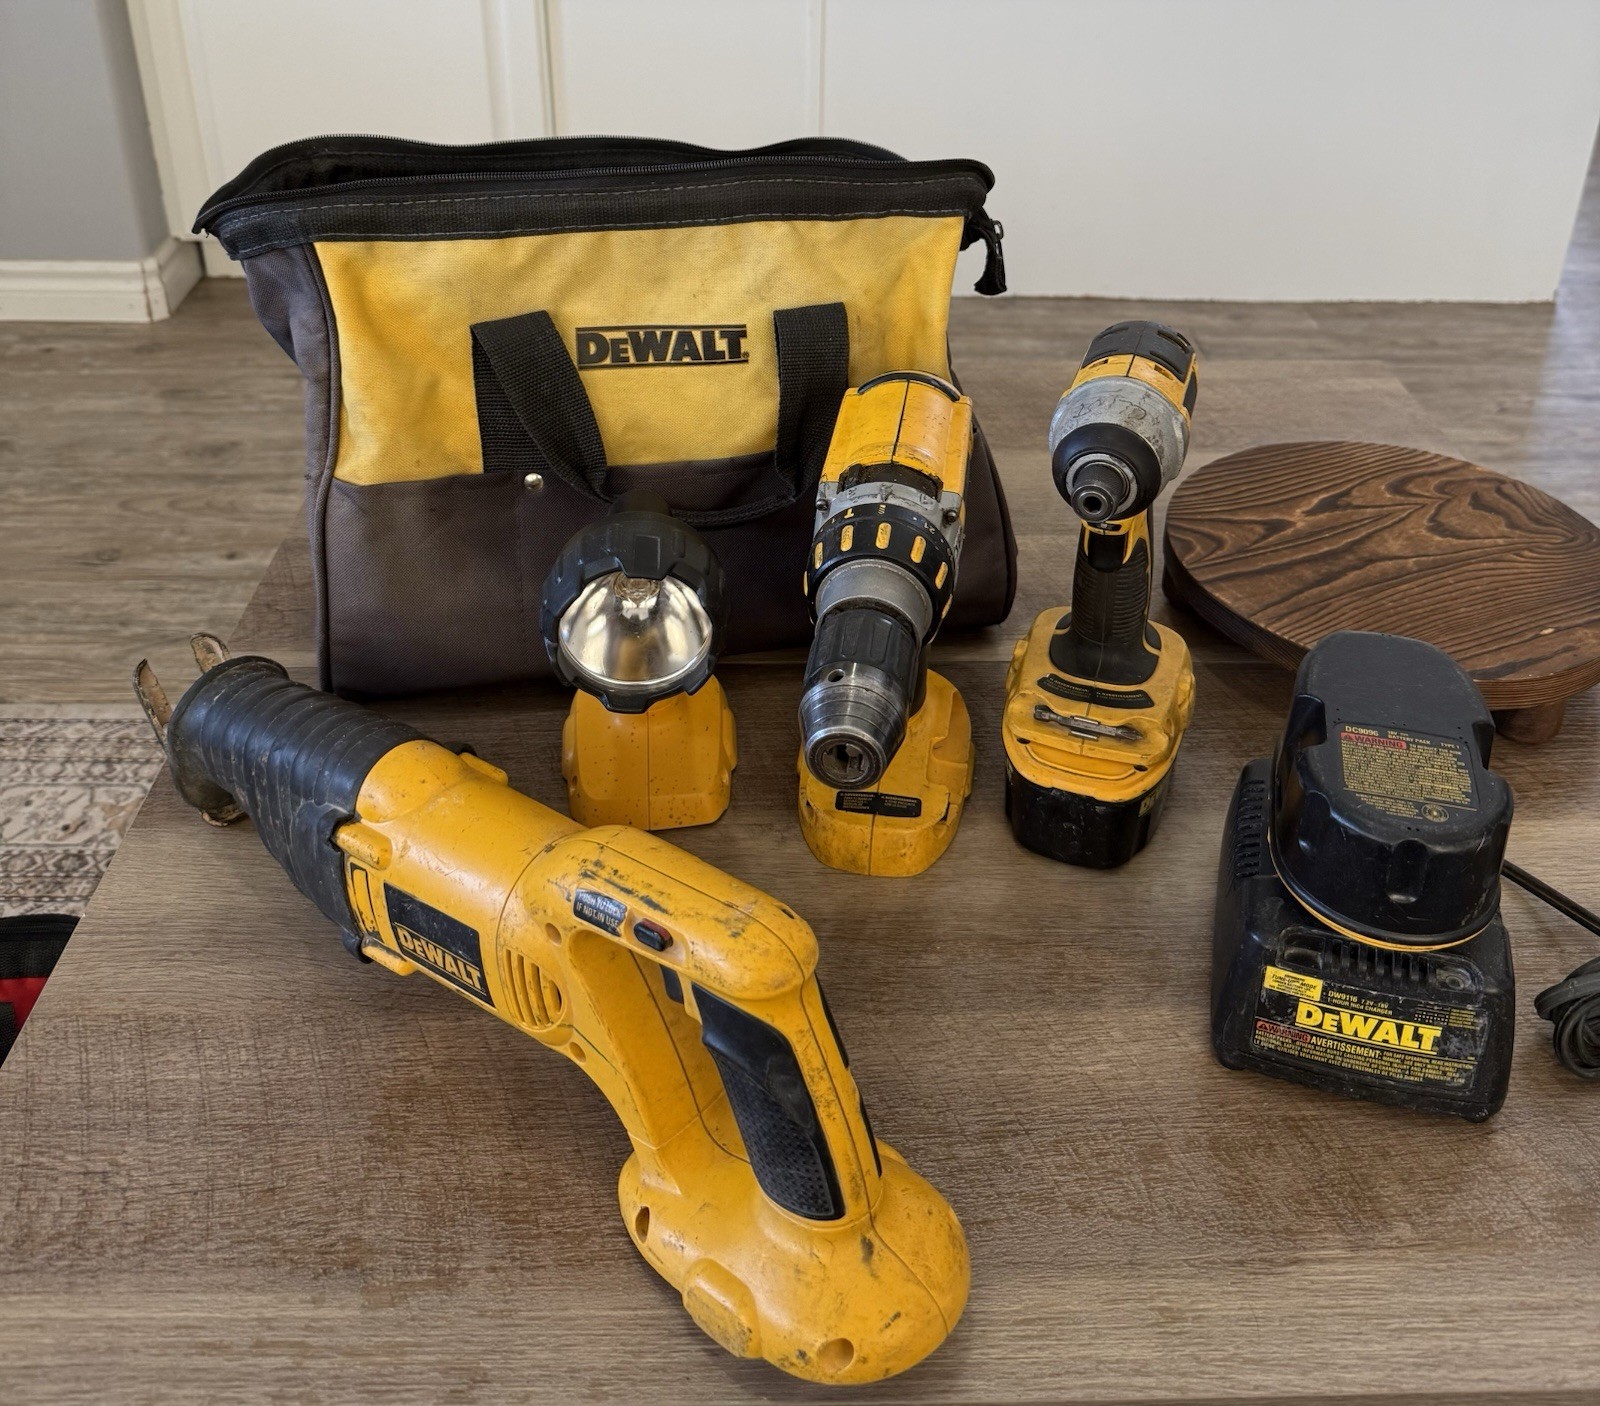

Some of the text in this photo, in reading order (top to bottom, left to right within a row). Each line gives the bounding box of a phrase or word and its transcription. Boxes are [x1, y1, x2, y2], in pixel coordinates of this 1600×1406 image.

[1345, 726, 1379, 736] DC9096
[1354, 735, 1405, 748] WARNING
[1388, 734, 1414, 742] BATTERY
[576, 902, 618, 928] IF NOT IN USE
[1301, 982, 1318, 990] MODE
[1328, 990, 1358, 1002] DW9116
[1364, 1005, 1393, 1016] CHARGER
[1268, 1024, 1382, 1059] WARNING AVERTISSEMENT:
[1300, 1052, 1328, 1062] SEULEMENT
[1302, 1047, 1334, 1059] INFORMATION
